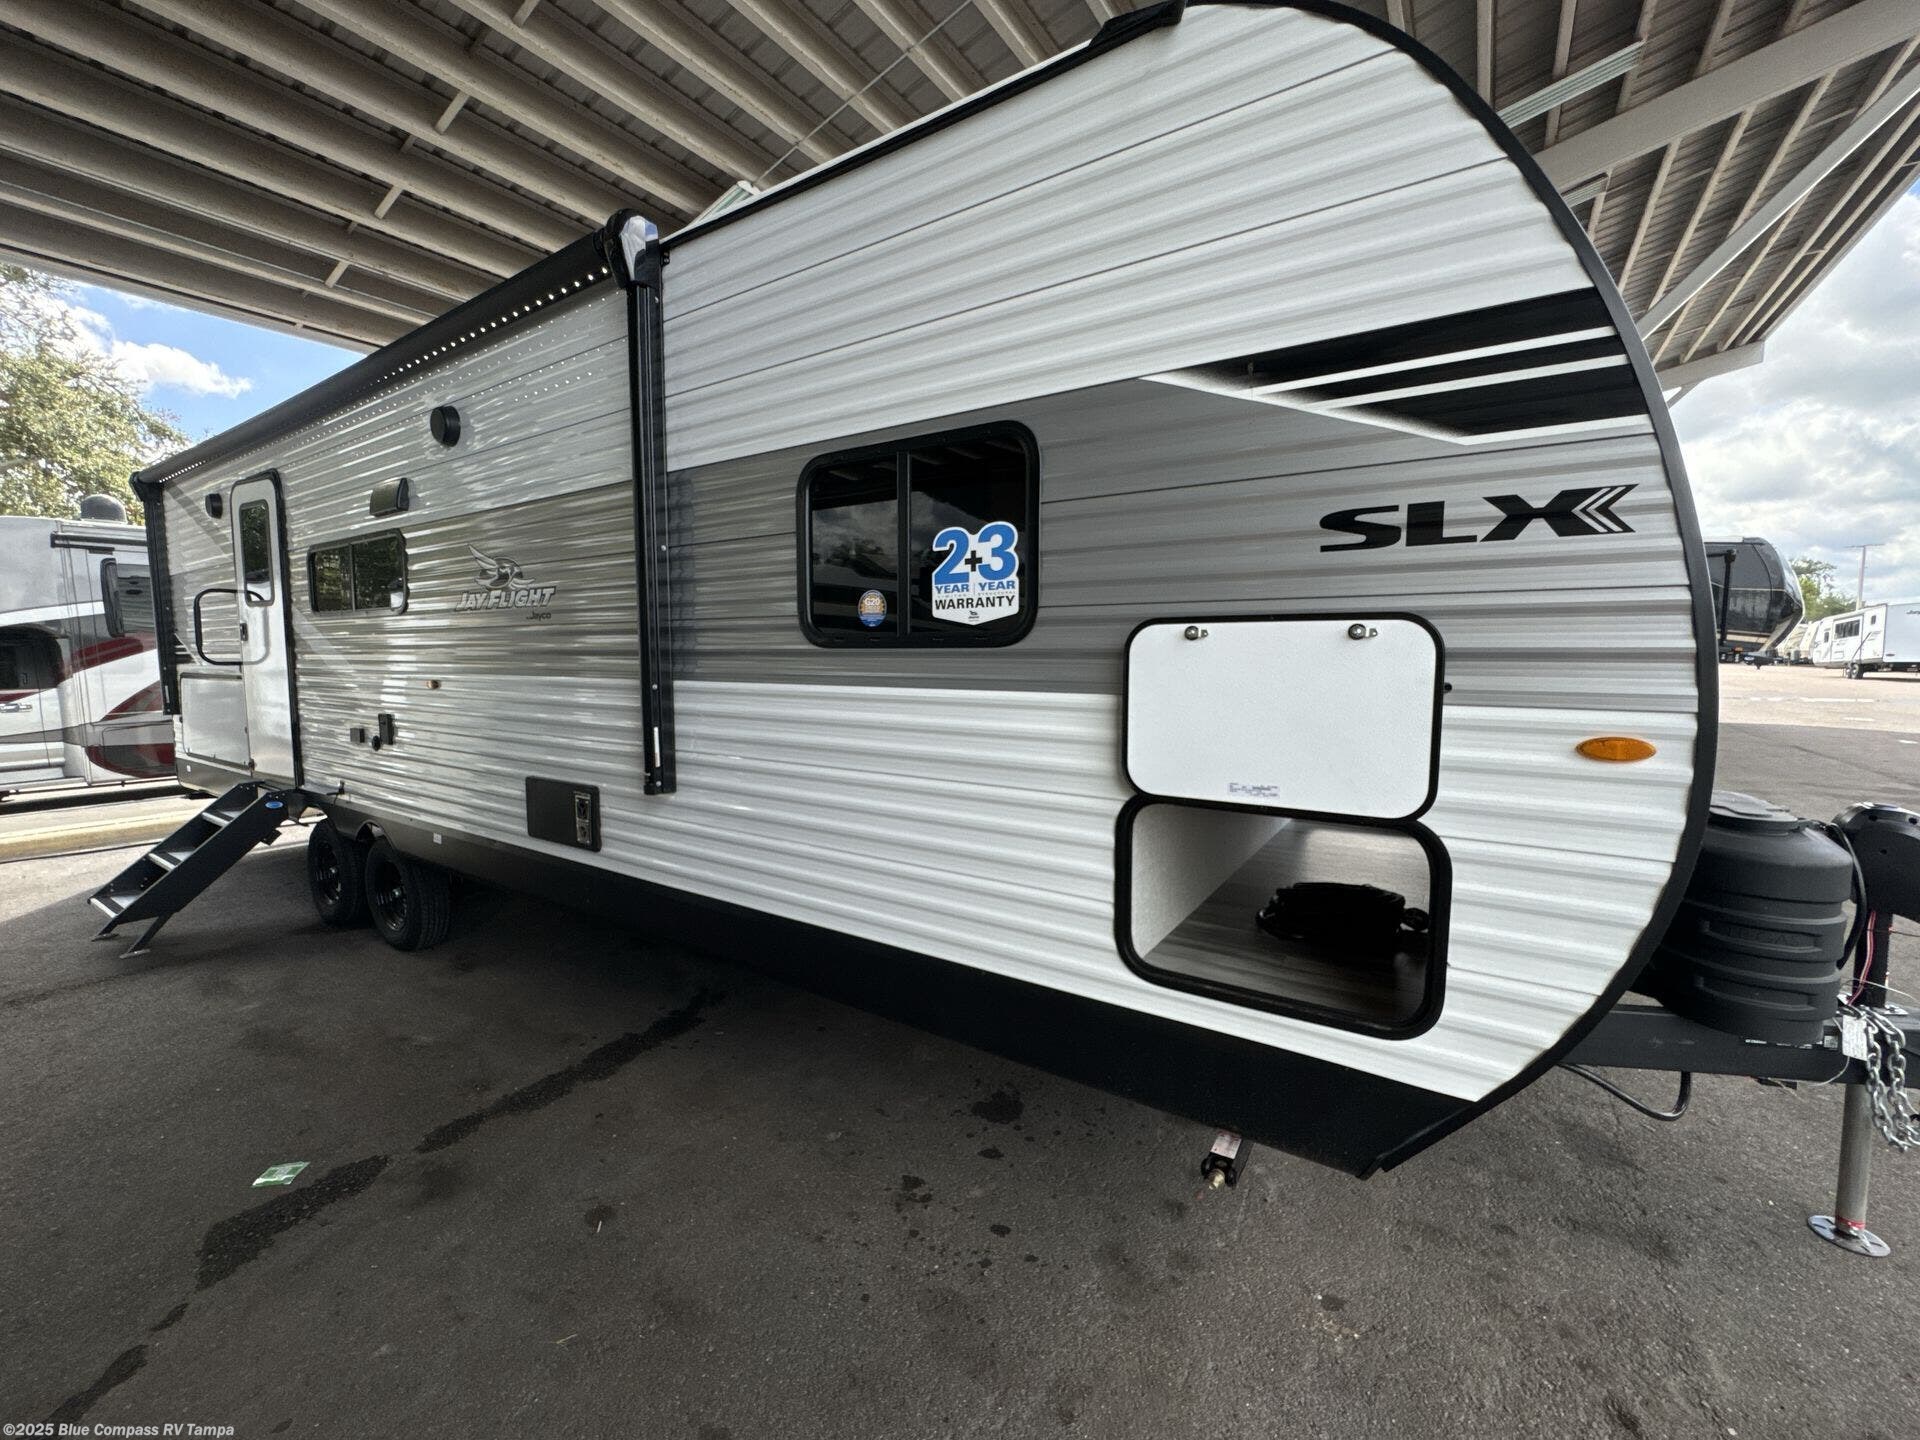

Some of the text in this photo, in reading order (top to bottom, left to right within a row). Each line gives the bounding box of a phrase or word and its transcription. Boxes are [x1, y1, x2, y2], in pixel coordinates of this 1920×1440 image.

[1320, 484, 1639, 552] SLX
[935, 581, 1015, 595] YEAR YEAR
[935, 596, 1015, 610] WARRANTY
